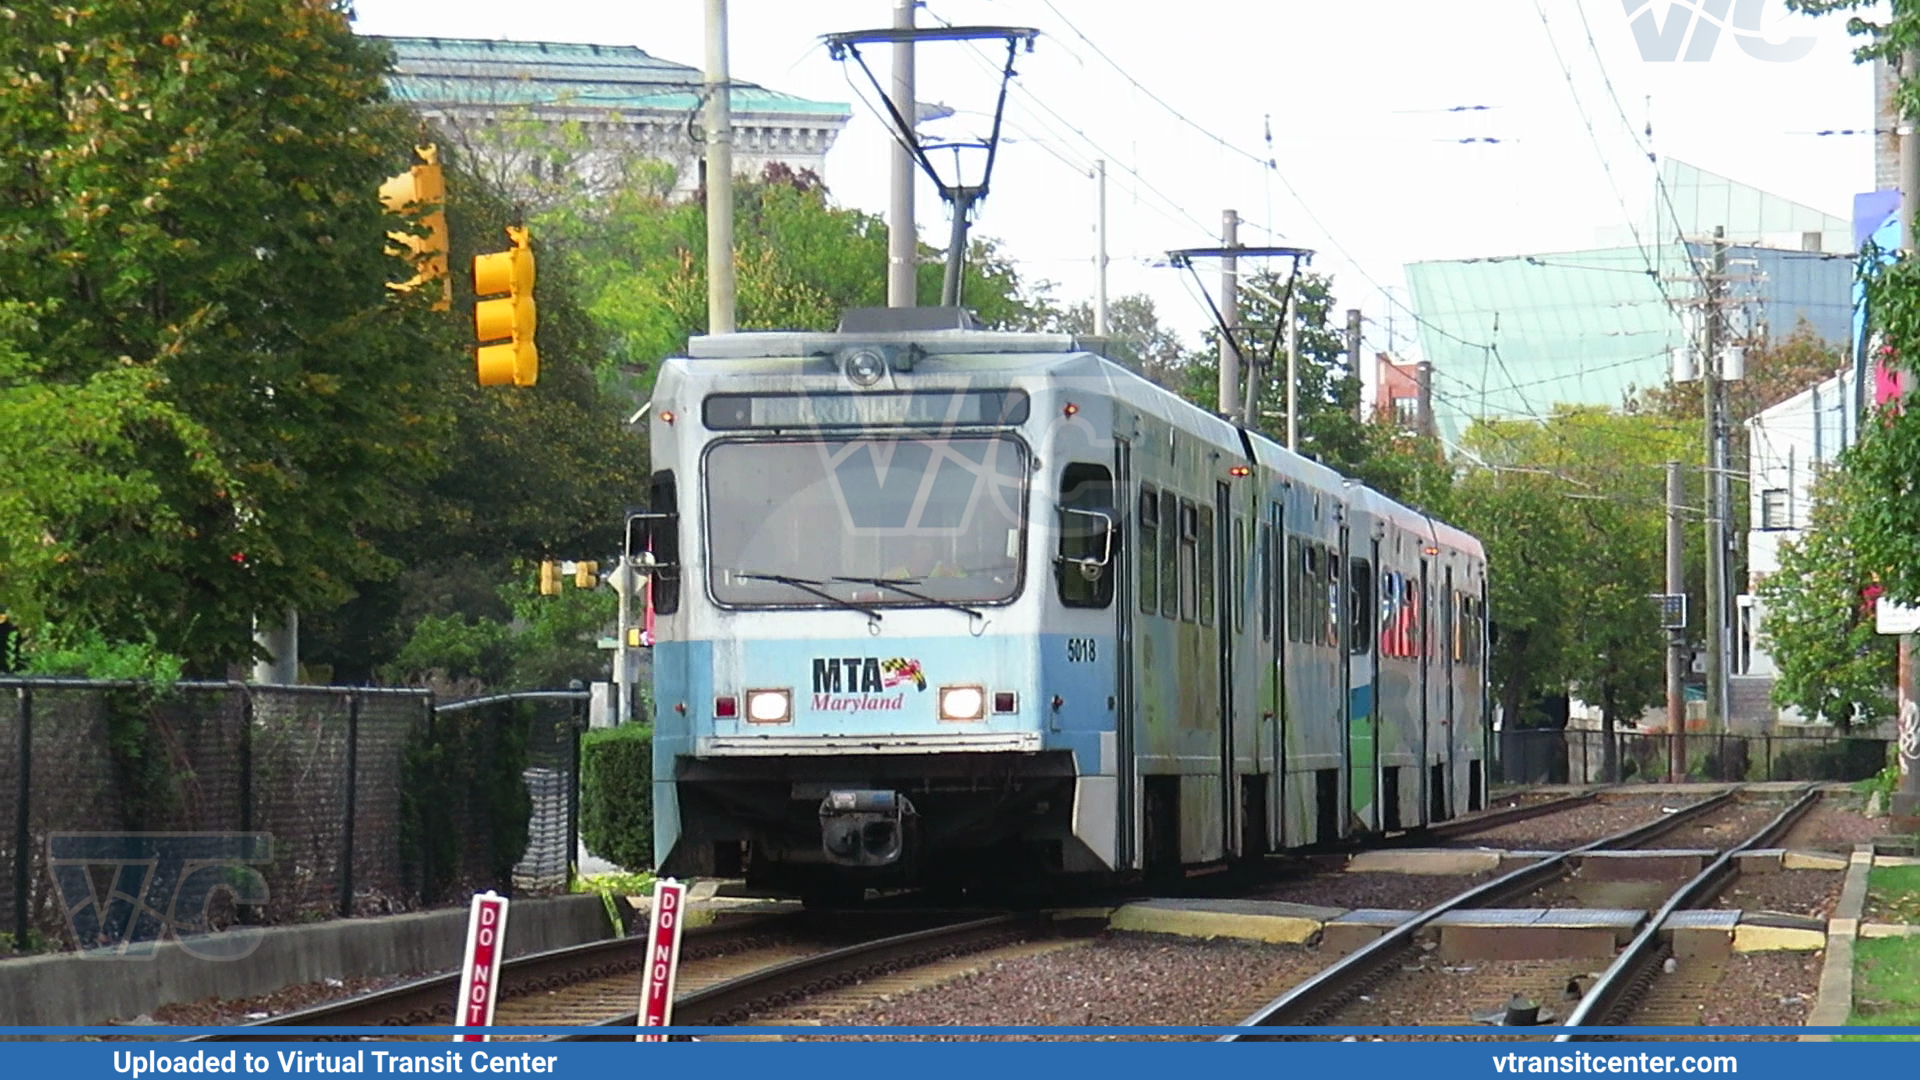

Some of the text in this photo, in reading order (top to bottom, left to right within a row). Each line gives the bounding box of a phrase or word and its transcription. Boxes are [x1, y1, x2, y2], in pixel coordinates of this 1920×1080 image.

[1067, 638, 1096, 662] 5018
[812, 657, 883, 693] MTA
[811, 693, 904, 715] Maryland
[660, 893, 675, 928] DO
[470, 907, 495, 1023] DO NOT
[653, 945, 670, 999] NOT
